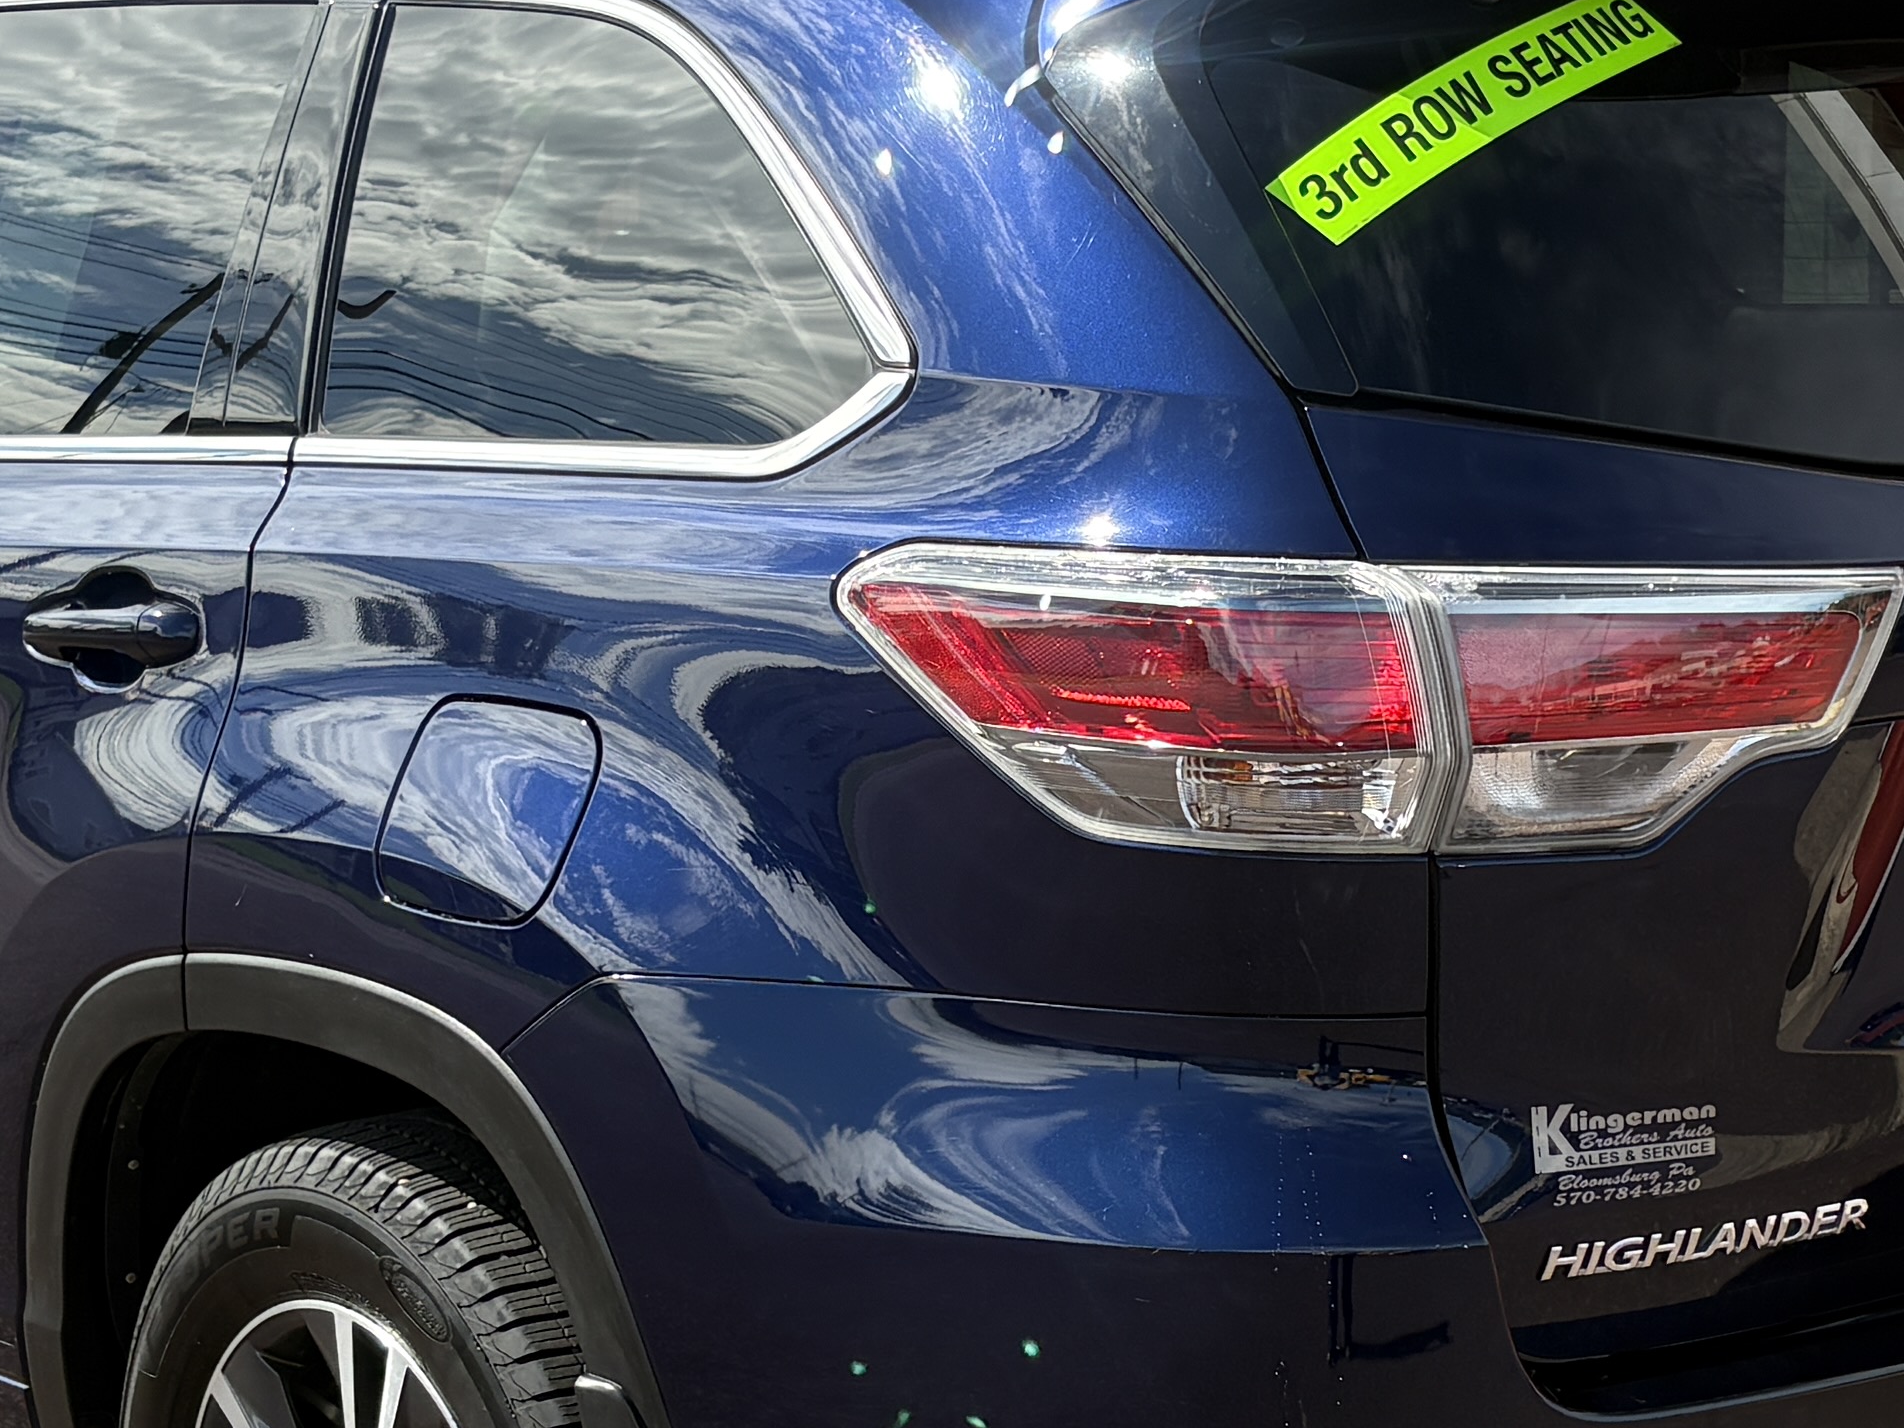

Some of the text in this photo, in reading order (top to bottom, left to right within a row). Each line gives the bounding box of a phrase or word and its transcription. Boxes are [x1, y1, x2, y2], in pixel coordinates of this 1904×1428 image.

[1299, 137, 1391, 221] 3rd
[1380, 70, 1494, 162] ROW
[1531, 1102, 1717, 1173] Klingerman
[1577, 1122, 1715, 1151] Brothers Auto
[1564, 1140, 1712, 1169] SALES & SERVICE
[1552, 1177, 1702, 1207] 570-784-4220
[1557, 1162, 1696, 1192] Bloomsburg Pa
[1540, 1197, 1869, 1281] HIGHLANDER
